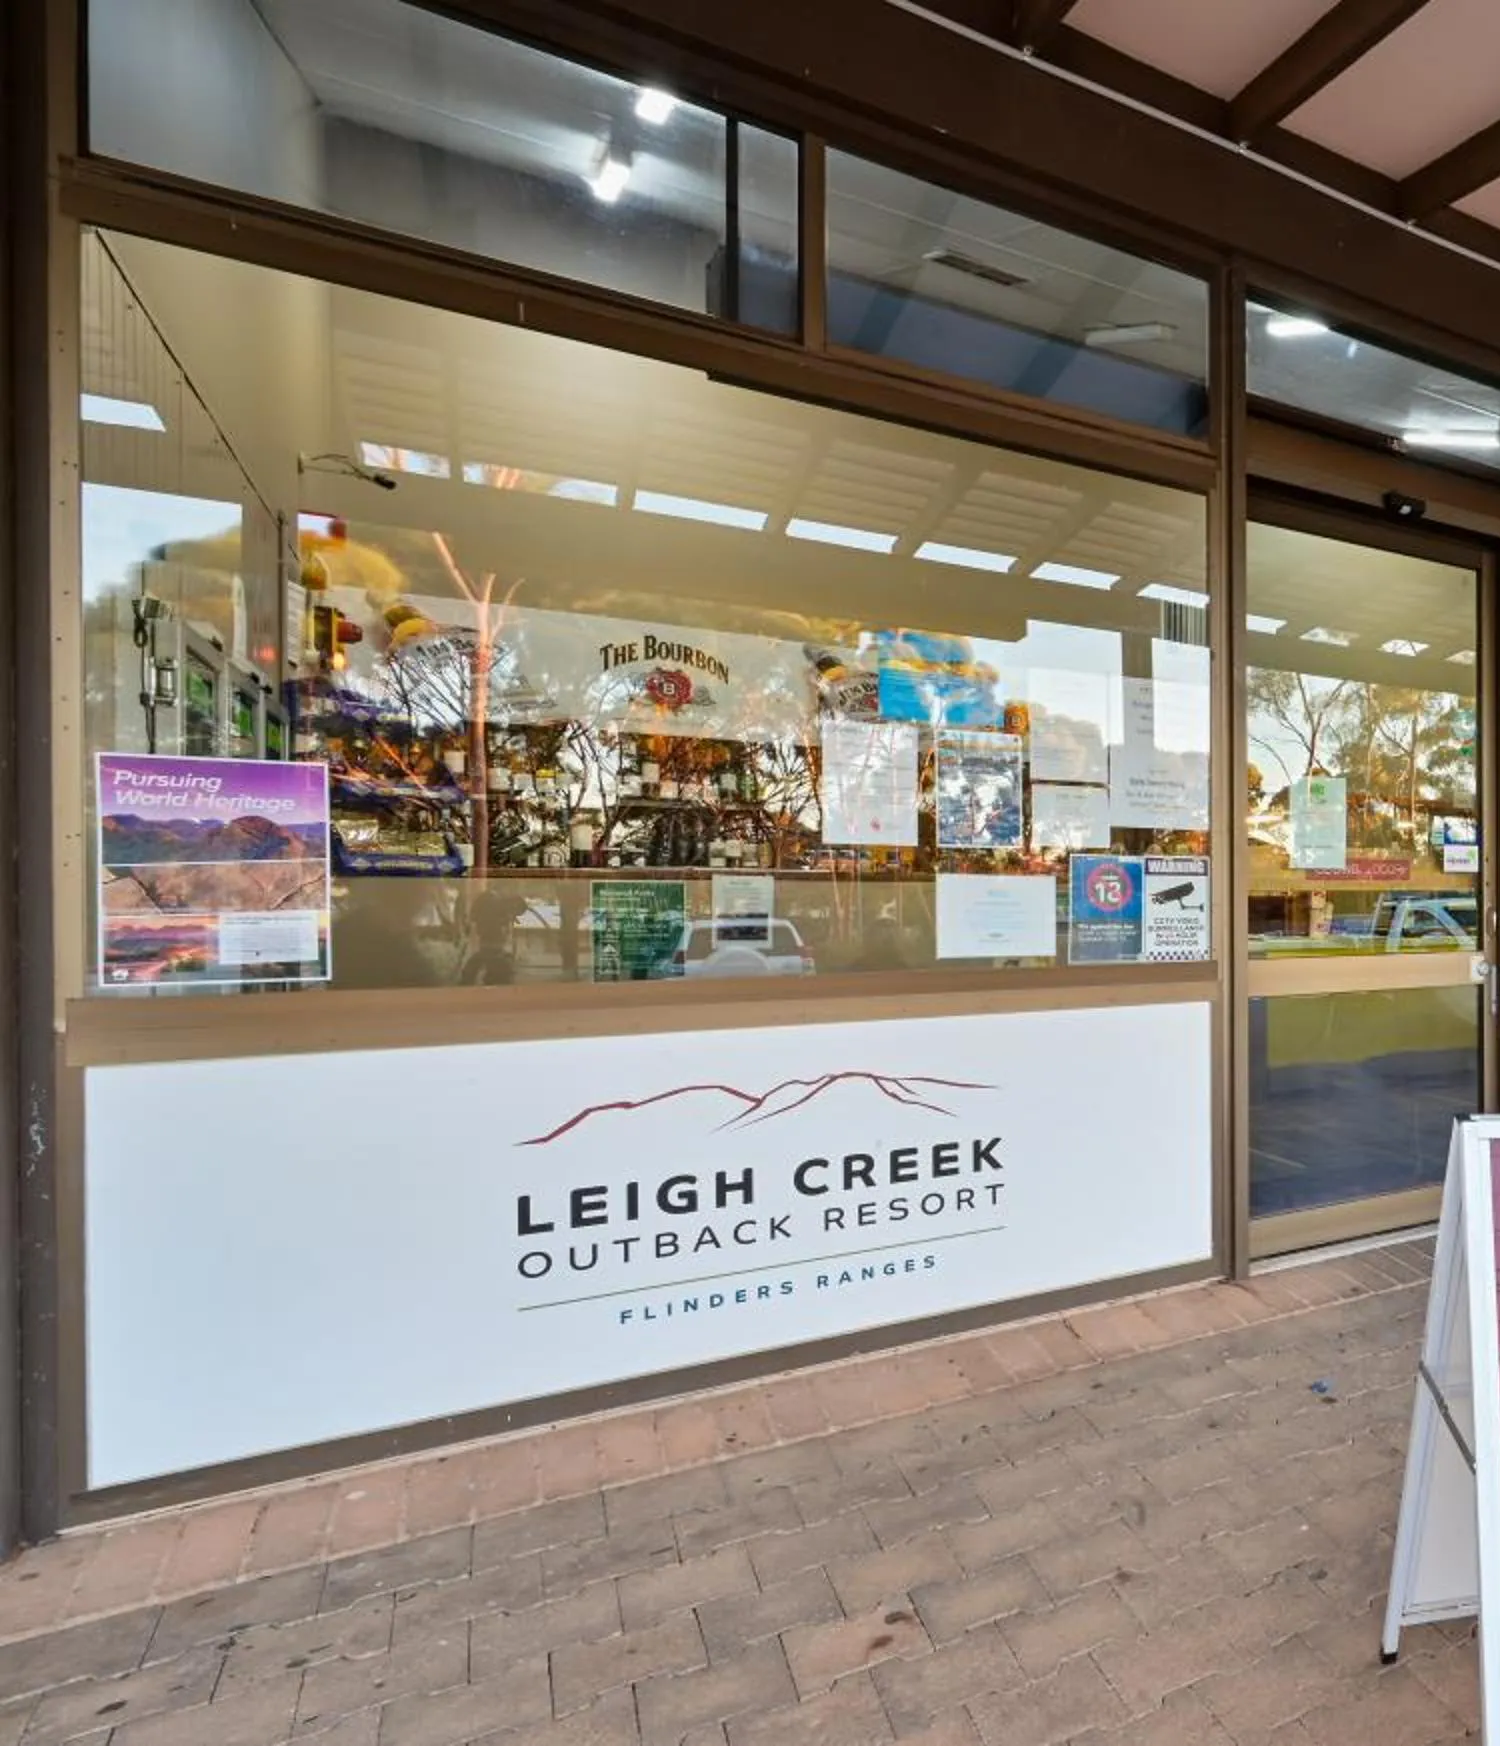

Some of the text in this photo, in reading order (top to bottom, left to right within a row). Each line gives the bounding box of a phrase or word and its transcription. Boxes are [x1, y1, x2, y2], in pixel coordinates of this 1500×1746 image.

[599, 634, 729, 685] THE BOURBON
[112, 769, 223, 793] Pursuing
[114, 789, 297, 813] World Heritage
[516, 1136, 1005, 1237] LEIGH CREEK
[517, 1183, 1006, 1280] OUTBACK RESORT
[619, 1254, 937, 1325] FLINDERS RANGES
